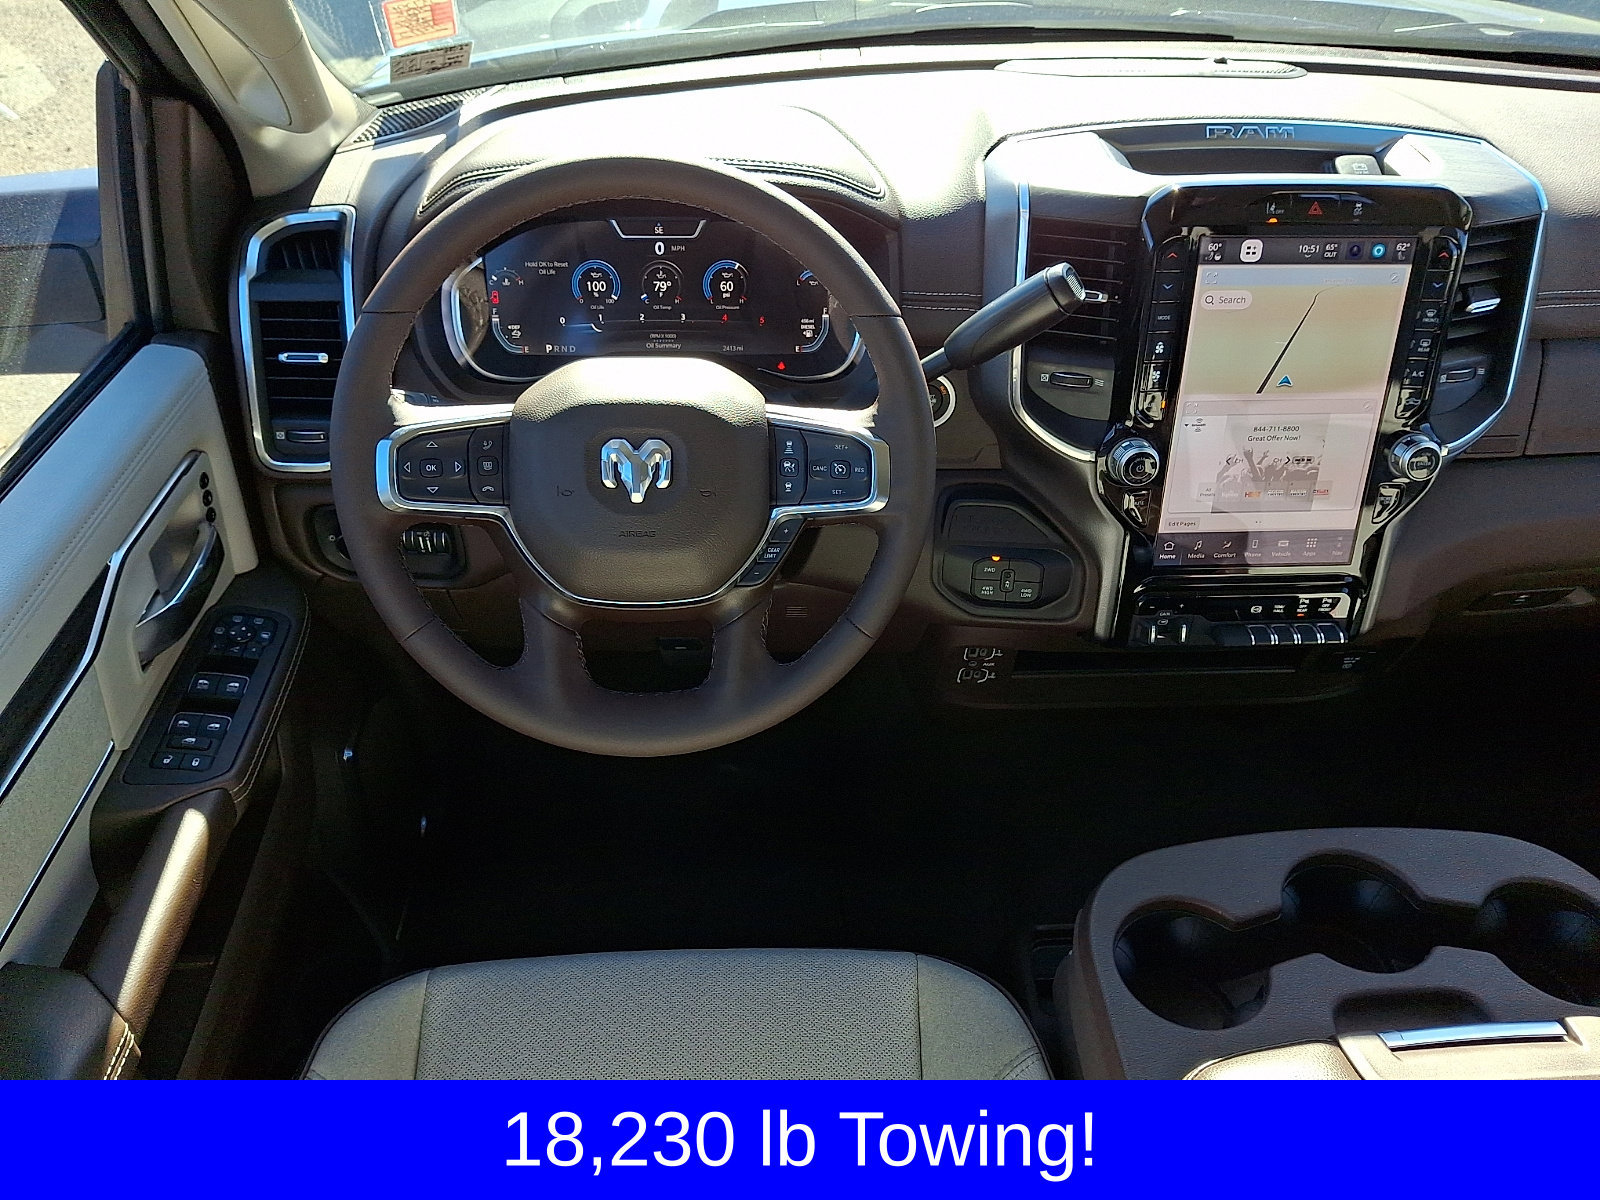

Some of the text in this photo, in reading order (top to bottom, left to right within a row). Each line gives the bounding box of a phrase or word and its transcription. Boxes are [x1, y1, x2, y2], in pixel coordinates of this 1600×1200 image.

[1206, 125, 1295, 139] RAM
[654, 226, 664, 235] SE
[654, 241, 665, 256] 0
[1208, 243, 1223, 252] 60°
[1299, 244, 1320, 253] 10:51
[1326, 243, 1338, 251] 65°
[1396, 243, 1411, 252] 62°
[586, 280, 607, 292] 100
[653, 280, 672, 292] 79°
[720, 281, 734, 292] 60
[1218, 295, 1247, 304] Search
[823, 307, 828, 315] F
[559, 316, 566, 324] 0
[639, 313, 645, 321] 2
[680, 313, 686, 321] 3
[722, 313, 727, 321] 4
[759, 316, 765, 324] 5
[524, 345, 530, 353] E
[545, 344, 576, 354] P R N D
[795, 345, 800, 353] E
[1411, 370, 1425, 378] A/C
[1266, 434, 1284, 442] Offer
[425, 464, 437, 472] OK
[618, 530, 656, 538] AIRBAG
